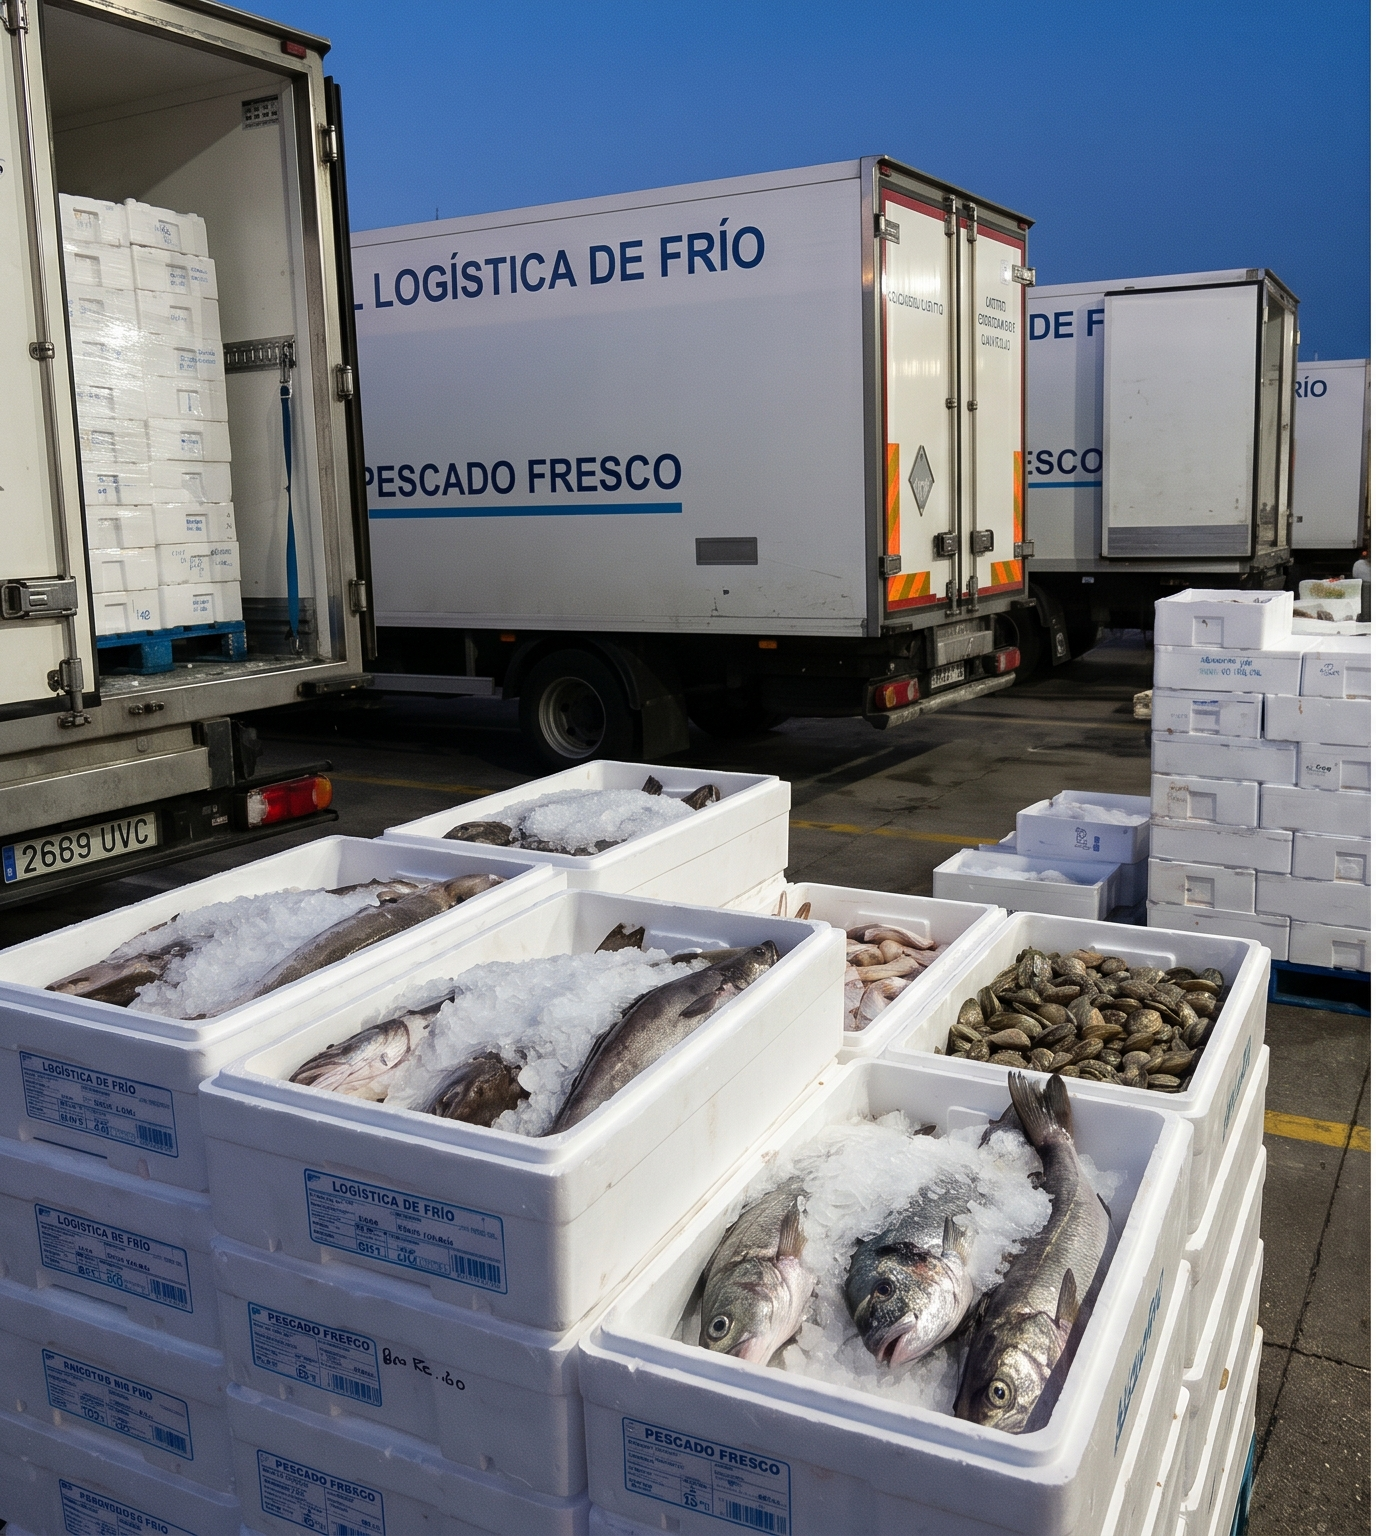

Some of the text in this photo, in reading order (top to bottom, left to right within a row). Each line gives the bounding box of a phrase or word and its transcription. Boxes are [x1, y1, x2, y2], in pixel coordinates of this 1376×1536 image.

[373, 217, 766, 309] LOGÍSTICA DE FRÍO
[1029, 310, 1074, 341] DE
[527, 453, 682, 494] FRESCO
[22, 817, 149, 875] 2689 UVC
[96, 1076, 110, 1088] DE
[403, 1198, 420, 1213] DE
[267, 1312, 321, 1336] PESCADO
[644, 1427, 781, 1476] PESCADO FRESCO
[275, 1459, 327, 1486] PESCADO
